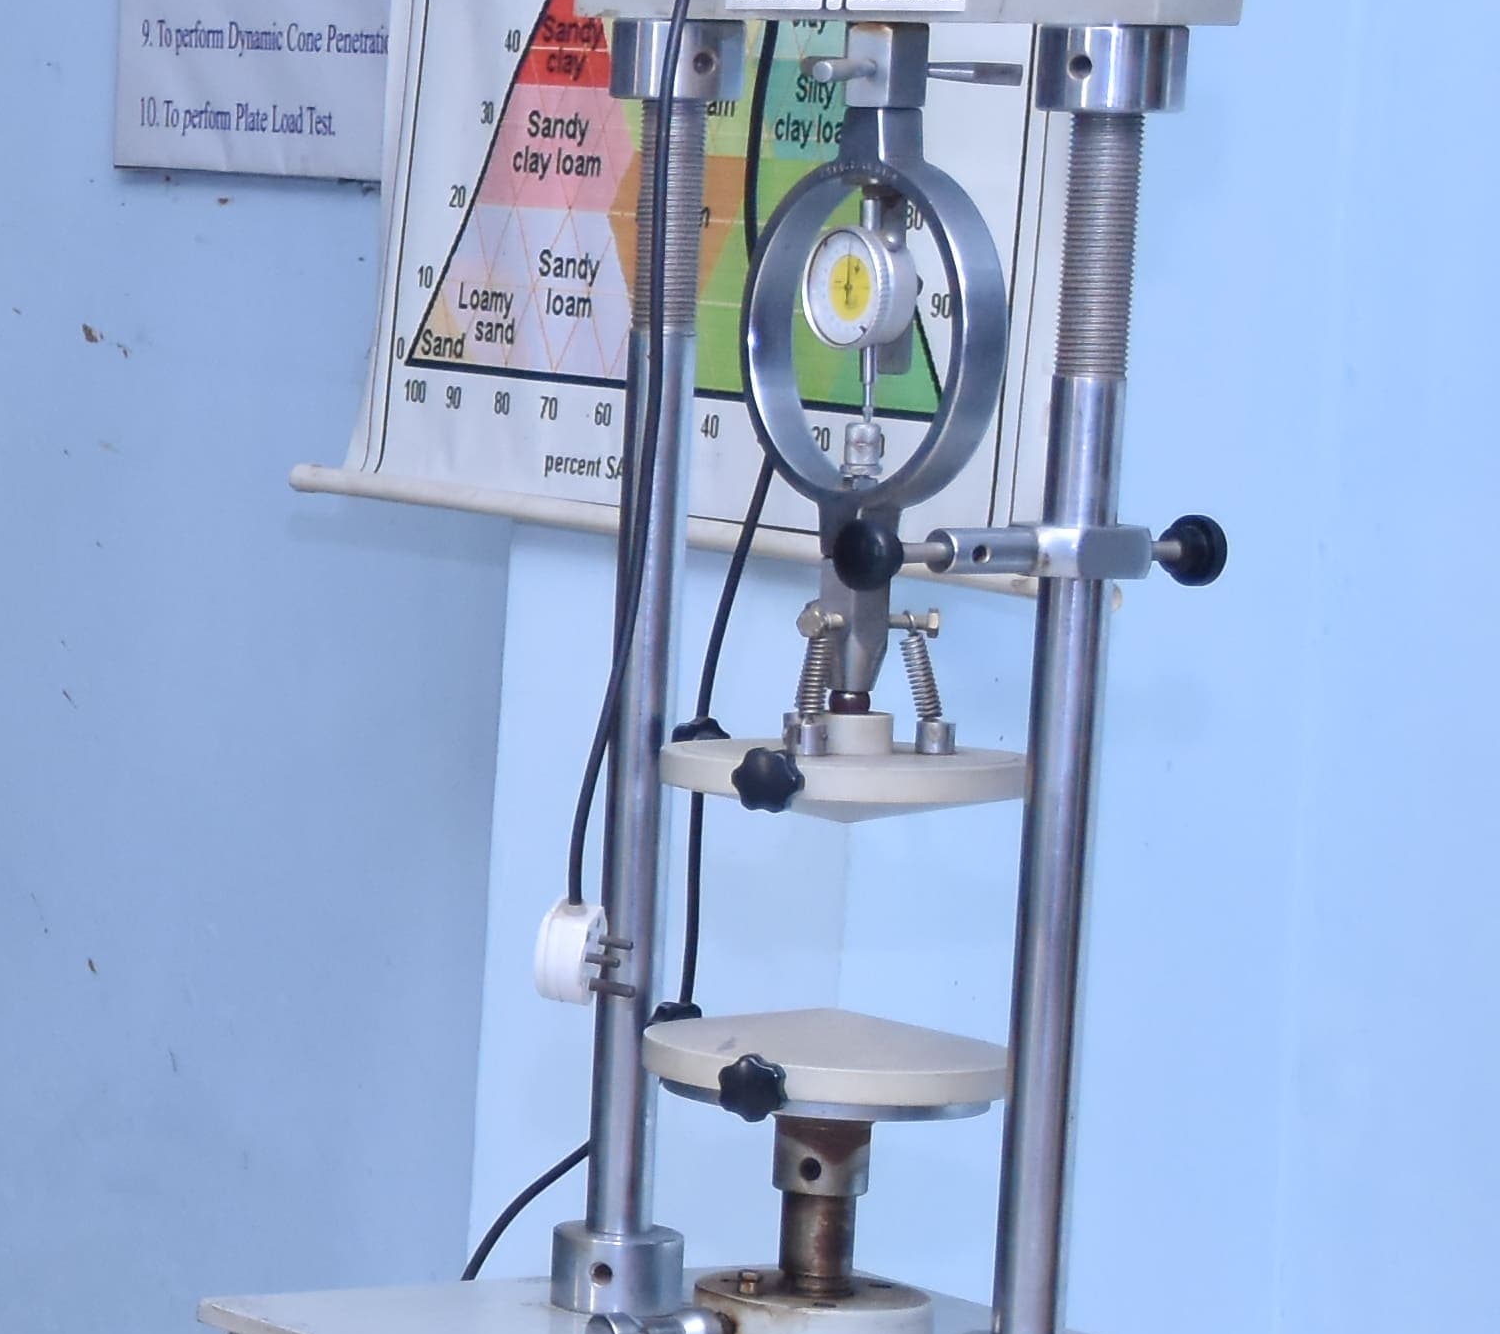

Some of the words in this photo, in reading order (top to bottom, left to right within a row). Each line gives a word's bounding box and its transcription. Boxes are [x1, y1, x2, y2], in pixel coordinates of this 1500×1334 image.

[504, 29, 521, 53] 40
[542, 15, 605, 47] Sandy
[546, 50, 589, 80] clay
[140, 97, 160, 128] 10.
[163, 99, 179, 130] To
[182, 100, 232, 137] perform
[235, 102, 268, 134] Plate
[271, 104, 303, 135] Load
[307, 106, 336, 137] Test.
[480, 100, 494, 124] 30
[527, 109, 590, 142] Sandy
[513, 145, 549, 180] clay
[556, 145, 602, 177] loam
[449, 184, 466, 208] 20
[417, 265, 434, 289] 10
[538, 248, 600, 287] Sandy
[458, 281, 514, 320] Loamy
[546, 288, 593, 318] loam
[931, 292, 950, 319] 90
[420, 328, 466, 359] Sand
[474, 317, 515, 345] sand
[396, 338, 405, 360] 0
[404, 379, 426, 403] 100
[445, 386, 461, 409] 90
[494, 391, 510, 416] 80
[540, 396, 558, 420] 70
[595, 403, 612, 428] 60
[701, 414, 719, 439] 40
[544, 453, 601, 479] percent
